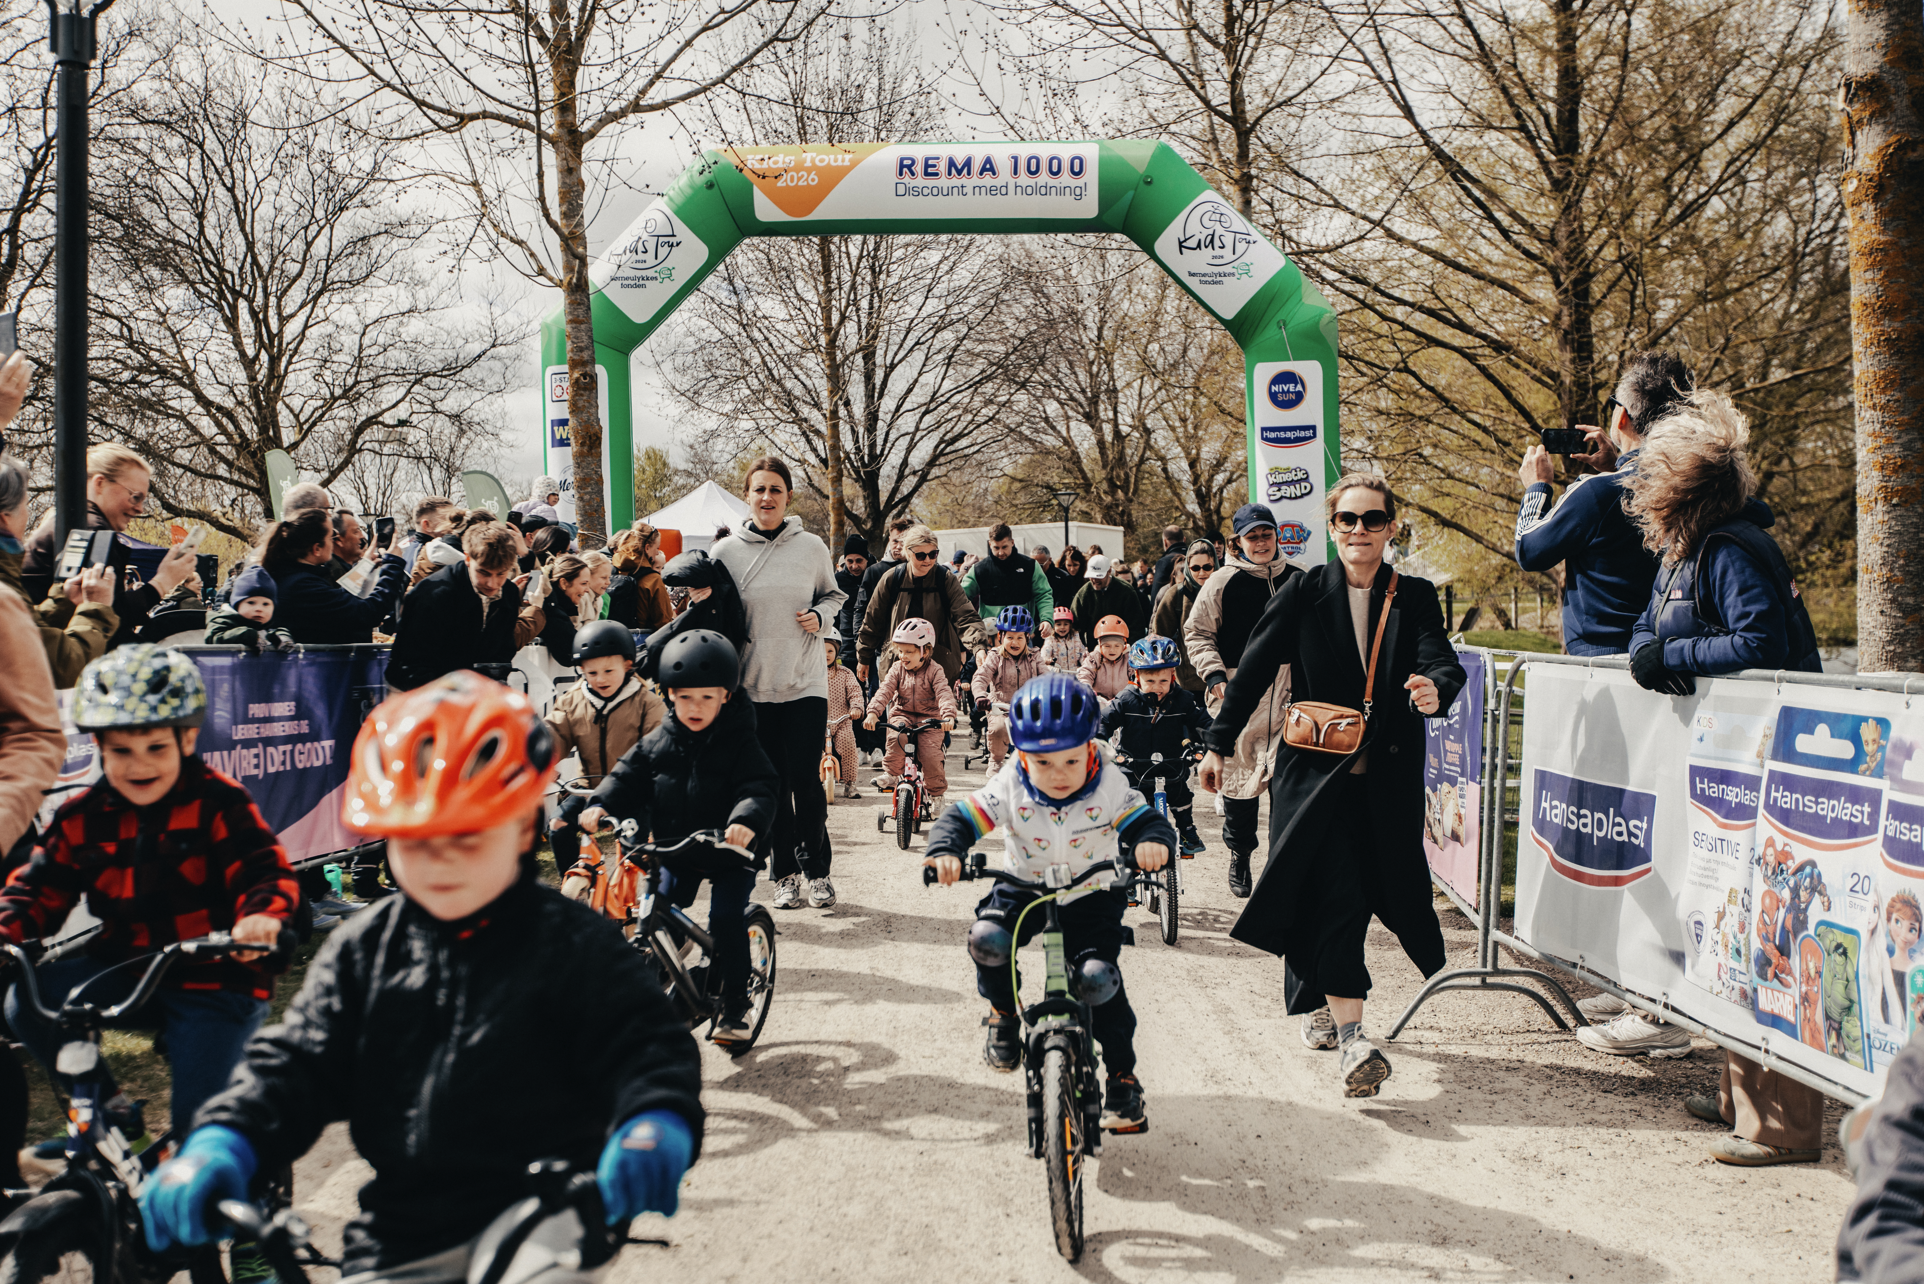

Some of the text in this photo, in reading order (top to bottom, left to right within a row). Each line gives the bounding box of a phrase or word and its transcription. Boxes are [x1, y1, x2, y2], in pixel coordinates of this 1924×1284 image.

[746, 153, 853, 169] Kids Tour
[896, 153, 1087, 179] REMA 1000
[776, 171, 819, 186] 2026
[895, 181, 1087, 201] Discount med holdning!
[648, 234, 682, 260] Tour
[1178, 229, 1257, 256] Kids Tour
[1271, 383, 1303, 393] NIVEA
[1263, 429, 1314, 440] Hansaplast
[266, 744, 293, 773] DET
[1695, 776, 1760, 807] Hansaplas
[1769, 783, 1872, 826] Hansaplast
[1538, 789, 1648, 848] Hansaplast
[1849, 871, 1871, 896] 20
[1757, 985, 1796, 1021] MARVEL
